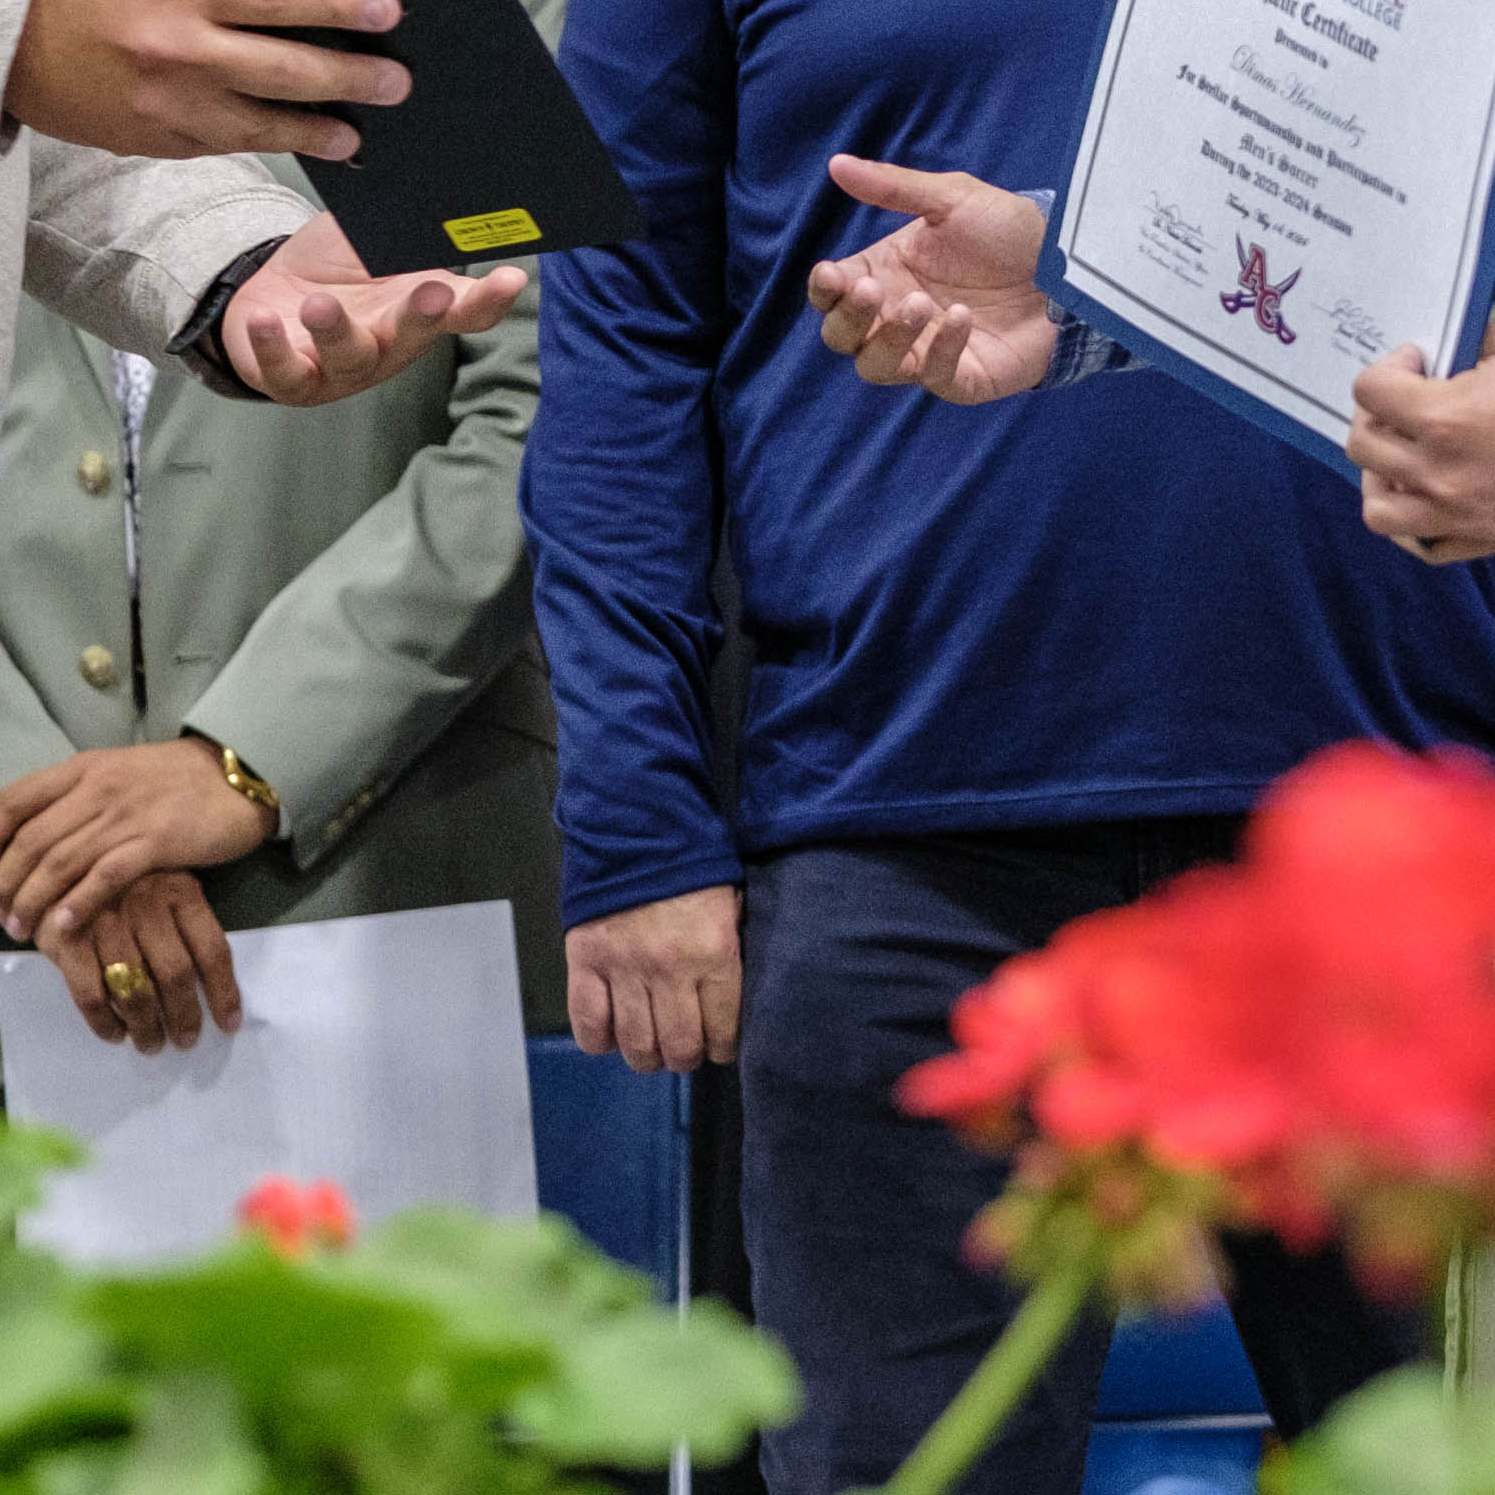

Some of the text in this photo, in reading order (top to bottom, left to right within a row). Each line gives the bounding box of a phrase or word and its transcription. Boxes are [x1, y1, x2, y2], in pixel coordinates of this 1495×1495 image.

[1300, 2, 1379, 62] Certificate
[1279, 72, 1366, 147] Hernandez
[1201, 137, 1235, 175] During
[1277, 153, 1319, 189] Soccer
[1326, 147, 1394, 197] Participation
